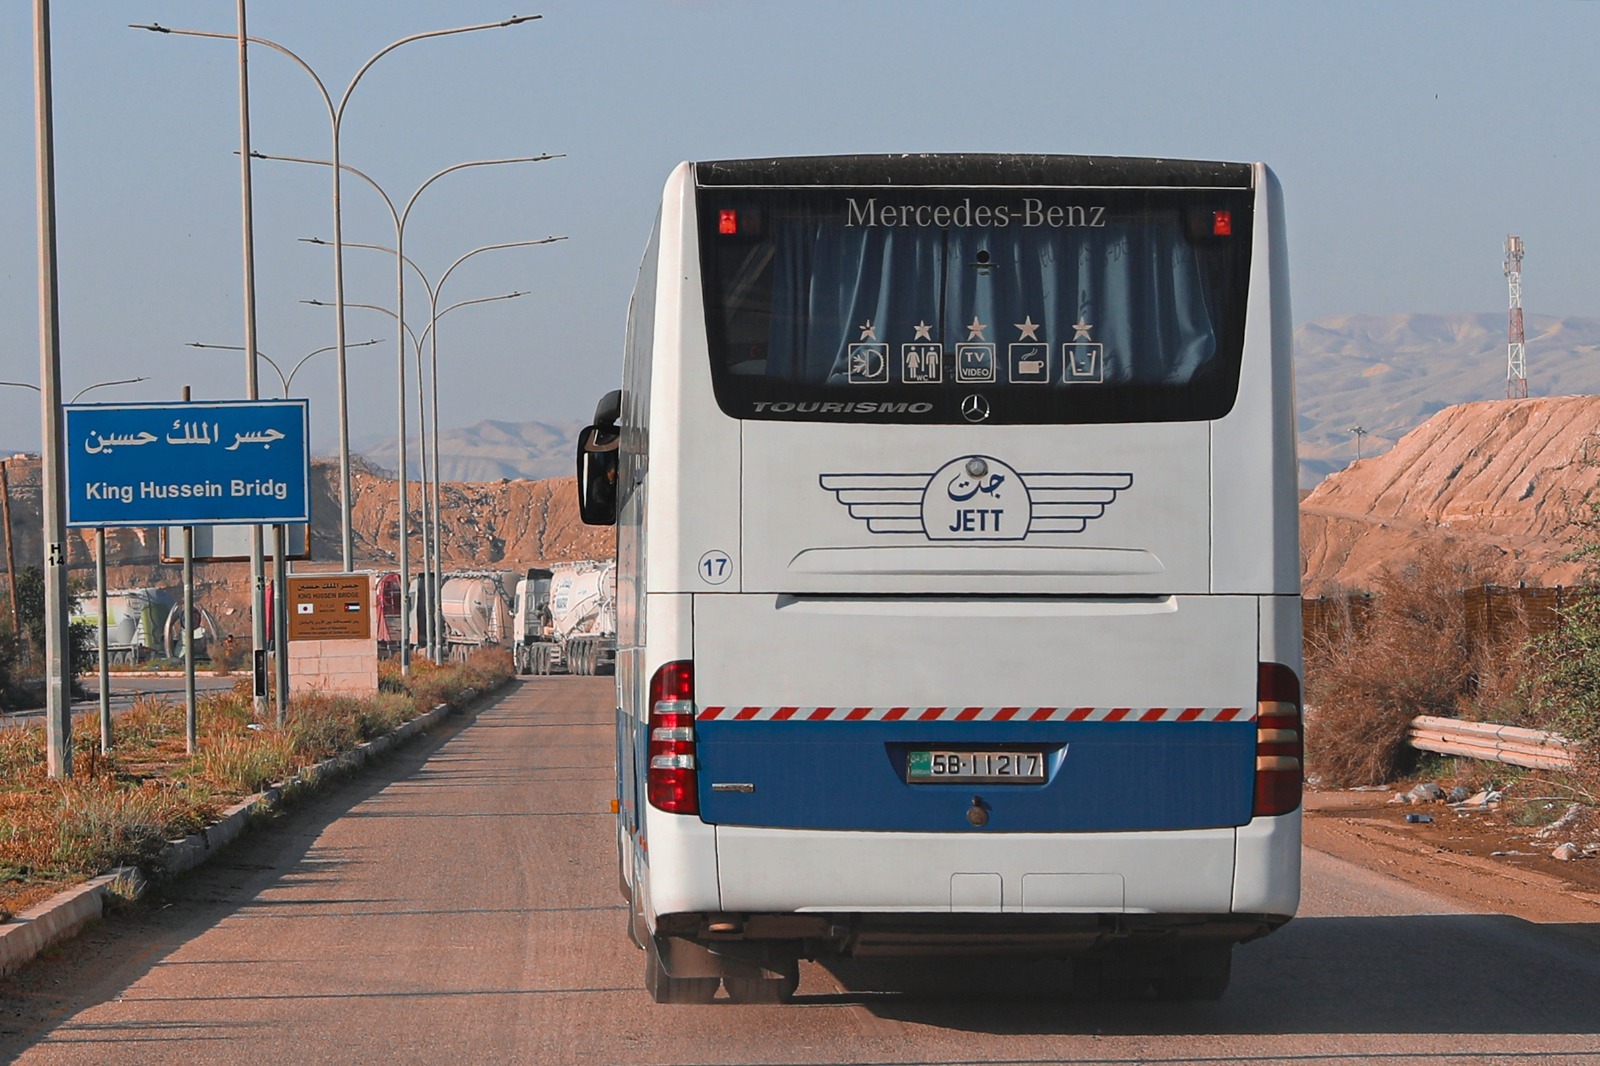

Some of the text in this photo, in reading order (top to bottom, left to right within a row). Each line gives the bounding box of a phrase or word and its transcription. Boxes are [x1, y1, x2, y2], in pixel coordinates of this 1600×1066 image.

[845, 197, 1106, 228] Mercedes-Benz
[965, 352, 985, 363] TV
[962, 368, 989, 377] VIDEO
[753, 401, 934, 414] TOURISMO
[84, 419, 286, 454] جسر الملك حسين
[85, 478, 287, 503] King Hussein Bridg
[949, 509, 1004, 532] JETT
[50, 543, 62, 554] H
[48, 555, 65, 567] 14
[703, 558, 728, 577] 17
